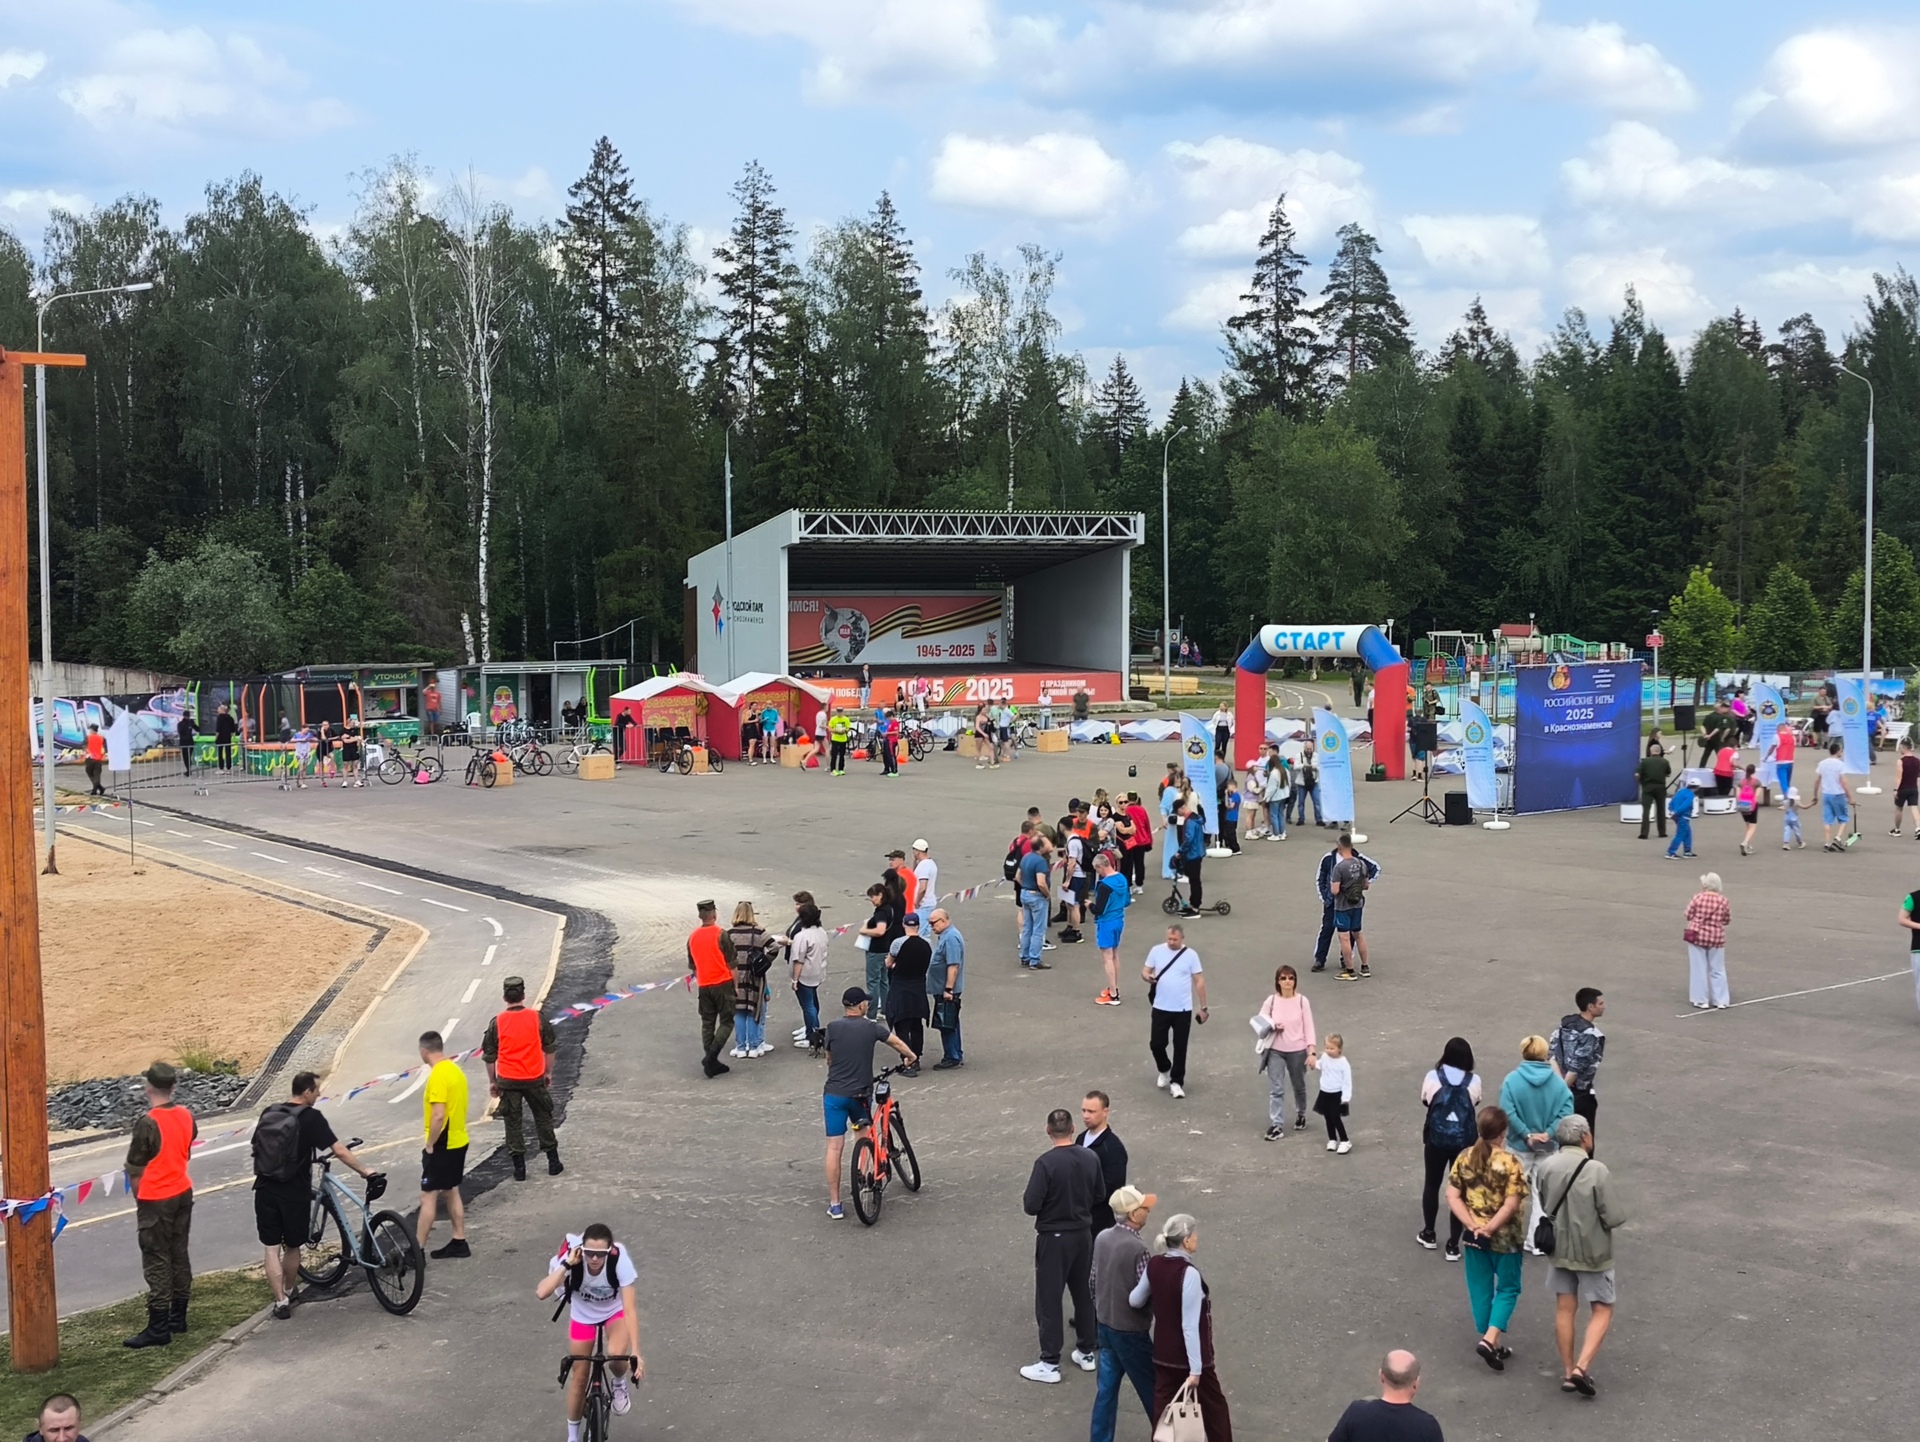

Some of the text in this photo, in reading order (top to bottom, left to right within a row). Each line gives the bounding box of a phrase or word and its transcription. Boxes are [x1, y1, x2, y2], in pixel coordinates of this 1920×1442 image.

[1274, 632, 1345, 651] СТАРТ
[373, 672, 408, 681] УТОЧКИ
[965, 678, 1014, 701] 2025
[1040, 679, 1087, 688] С ПРАЗДНИКОМ
[835, 687, 862, 699] ПОБЕД
[897, 679, 945, 702] 195
[1544, 695, 1614, 708] РОССИЙСКИЕ ИГРЫ
[1565, 708, 1594, 720] 2025
[1544, 721, 1613, 734] в Краснознаменске
